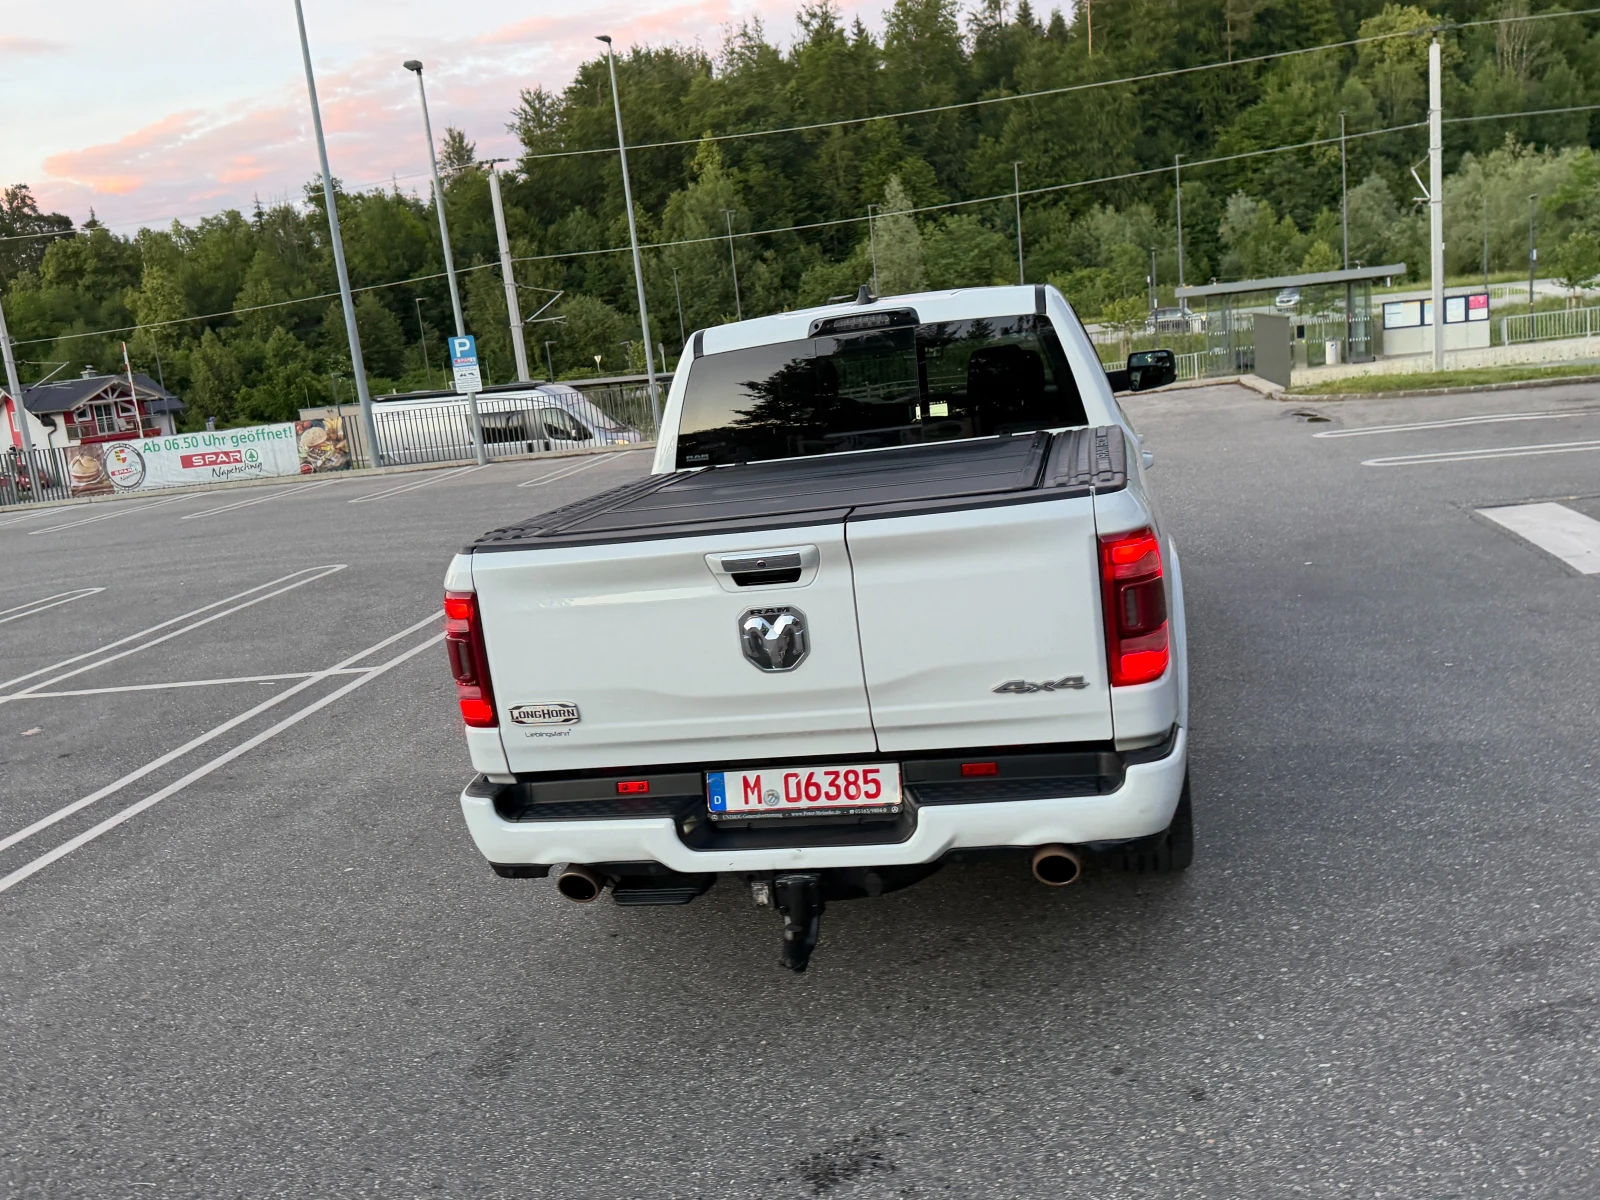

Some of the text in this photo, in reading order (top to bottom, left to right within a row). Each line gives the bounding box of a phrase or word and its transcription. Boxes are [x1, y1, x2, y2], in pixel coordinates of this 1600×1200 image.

[454, 339, 470, 357] P
[143, 439, 161, 454] Ab
[164, 436, 199, 451] 06.50
[202, 434, 226, 447] Uhr
[231, 426, 293, 447] geöffnet!
[192, 452, 242, 466] SPAR
[749, 607, 790, 615] RAM
[714, 768, 882, 805] D M 06385
